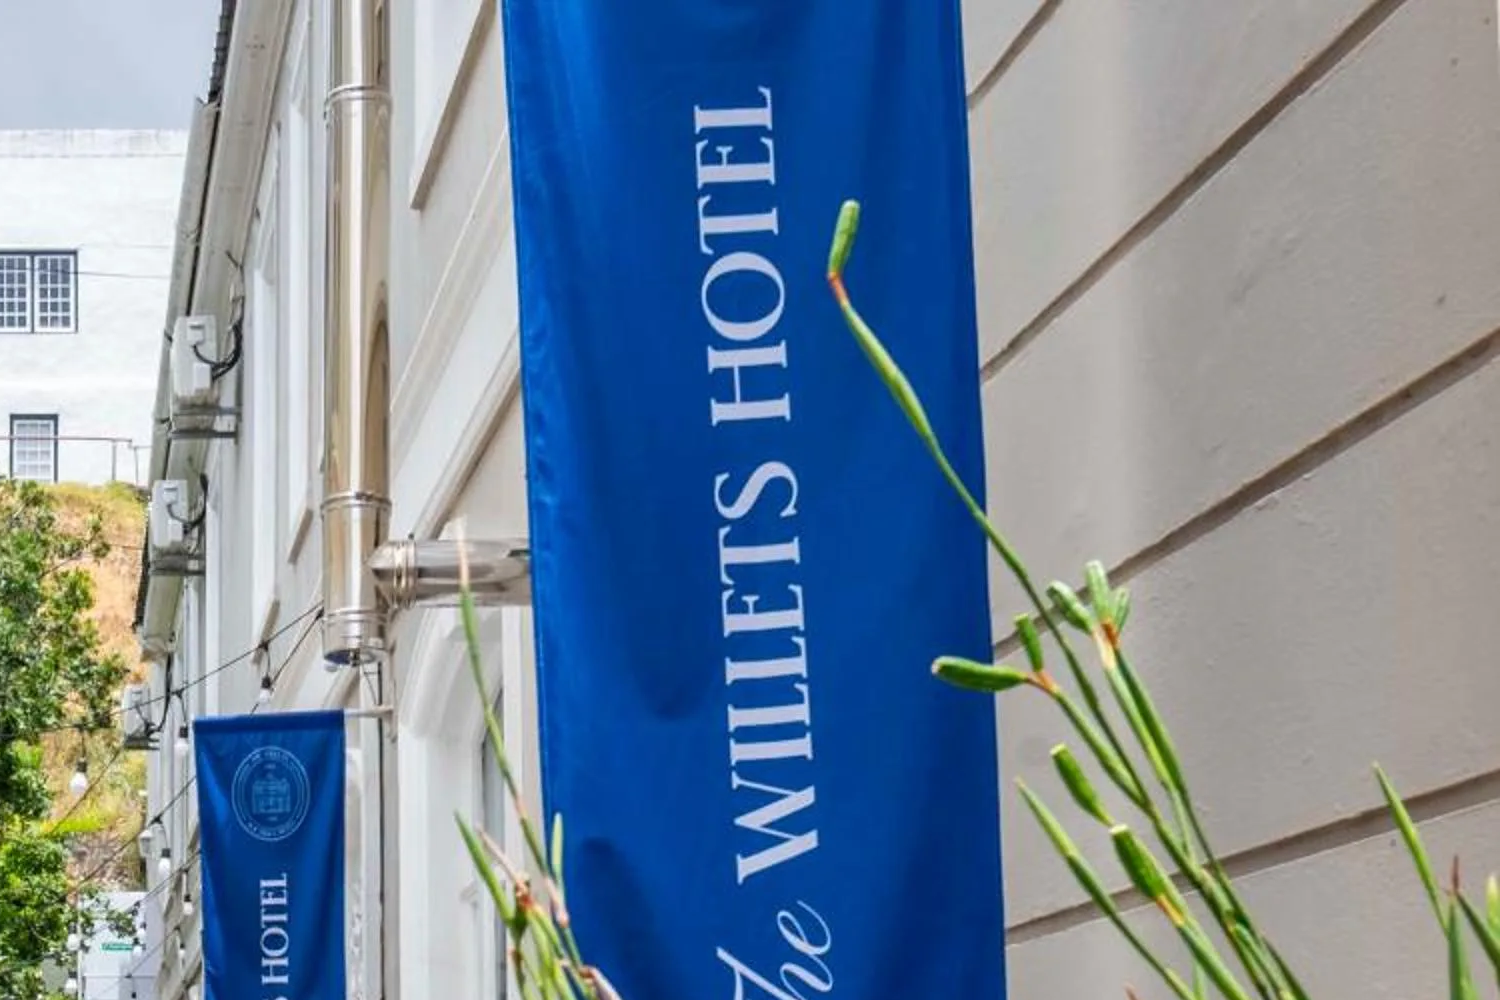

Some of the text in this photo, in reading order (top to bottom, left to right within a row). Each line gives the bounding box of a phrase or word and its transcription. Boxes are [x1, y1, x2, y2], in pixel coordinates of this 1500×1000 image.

[692, 85, 793, 426] HOTEL
[712, 458, 820, 886] WILLETS
[258, 873, 289, 985] HOTEL
